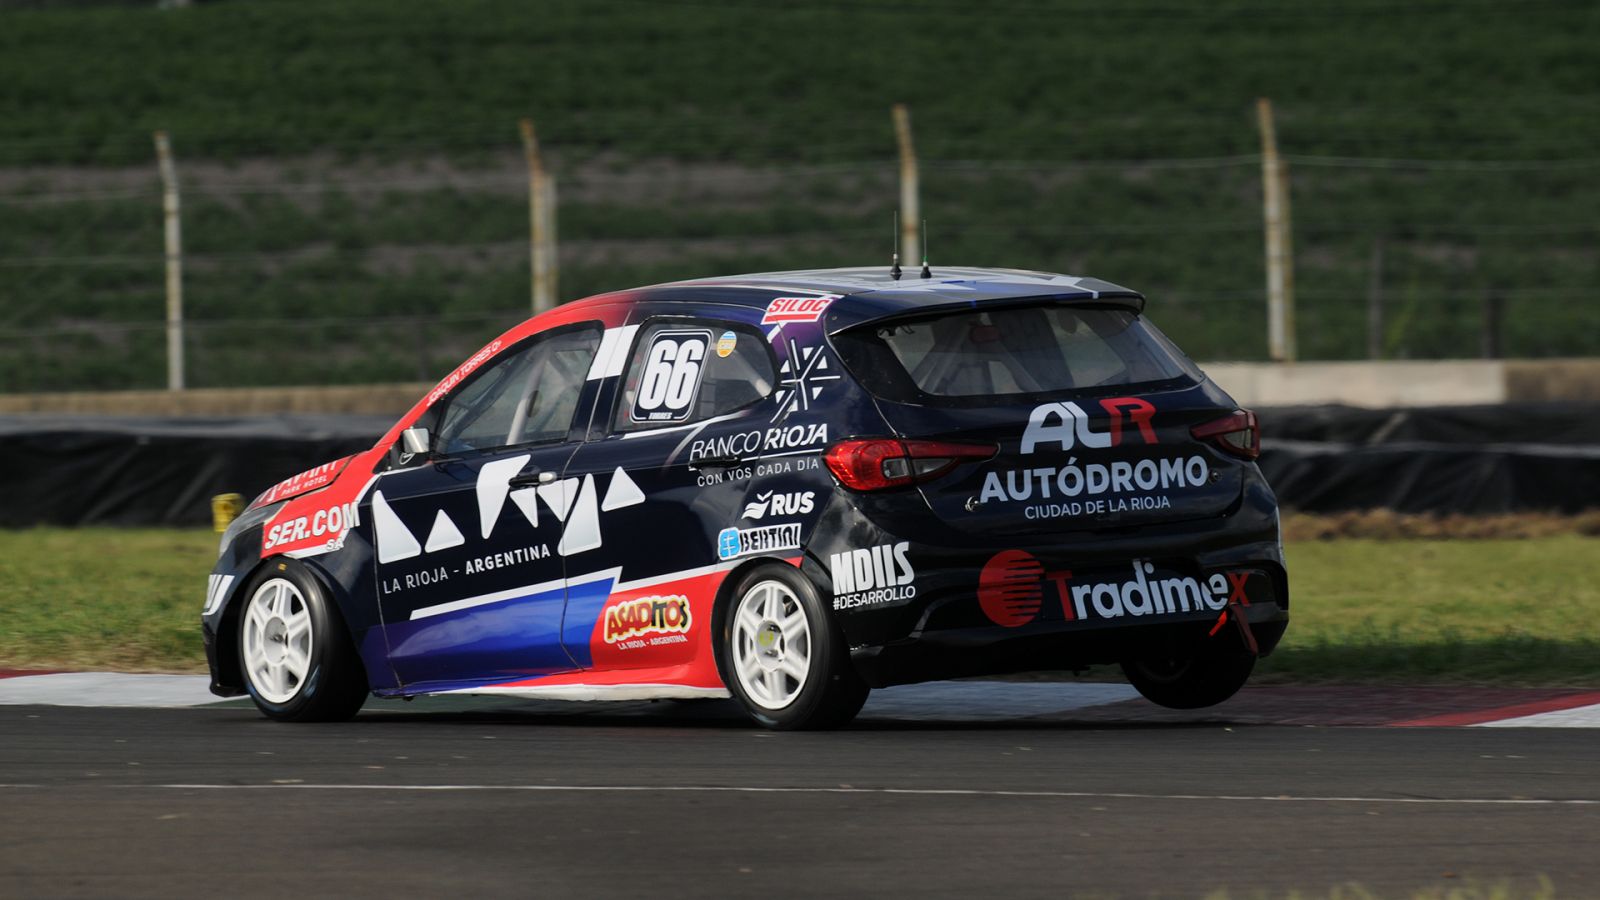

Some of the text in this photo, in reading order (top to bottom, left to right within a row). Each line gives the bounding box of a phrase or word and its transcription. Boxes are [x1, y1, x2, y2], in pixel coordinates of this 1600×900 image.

[769, 299, 831, 313] SILOC
[426, 371, 460, 406] JOAQUIN
[460, 346, 492, 375] TORRES
[638, 339, 705, 410] 66
[1020, 396, 1159, 454] ALR
[281, 475, 327, 497] PARK HOTEL
[697, 457, 819, 487] CON VOS CADA DÍA
[979, 455, 1208, 503] AUTÓDROMO
[770, 490, 815, 516] RUS
[1024, 495, 1171, 520] CIUDAD DE LA RIOJA
[264, 501, 360, 550] SER.COM
[739, 525, 799, 552] BERTINI
[383, 577, 401, 594] LA
[405, 567, 448, 589] RIOJA
[465, 543, 551, 575] ARGENTINA
[830, 541, 915, 596] MDIIS
[1044, 558, 1250, 622] Tradimex
[606, 598, 689, 641] ASADITOS
[832, 585, 916, 611] #DESARROLLO
[617, 642, 629, 650] LA
[629, 640, 646, 649] RIOJA
[650, 634, 688, 646] ARGENTINA
